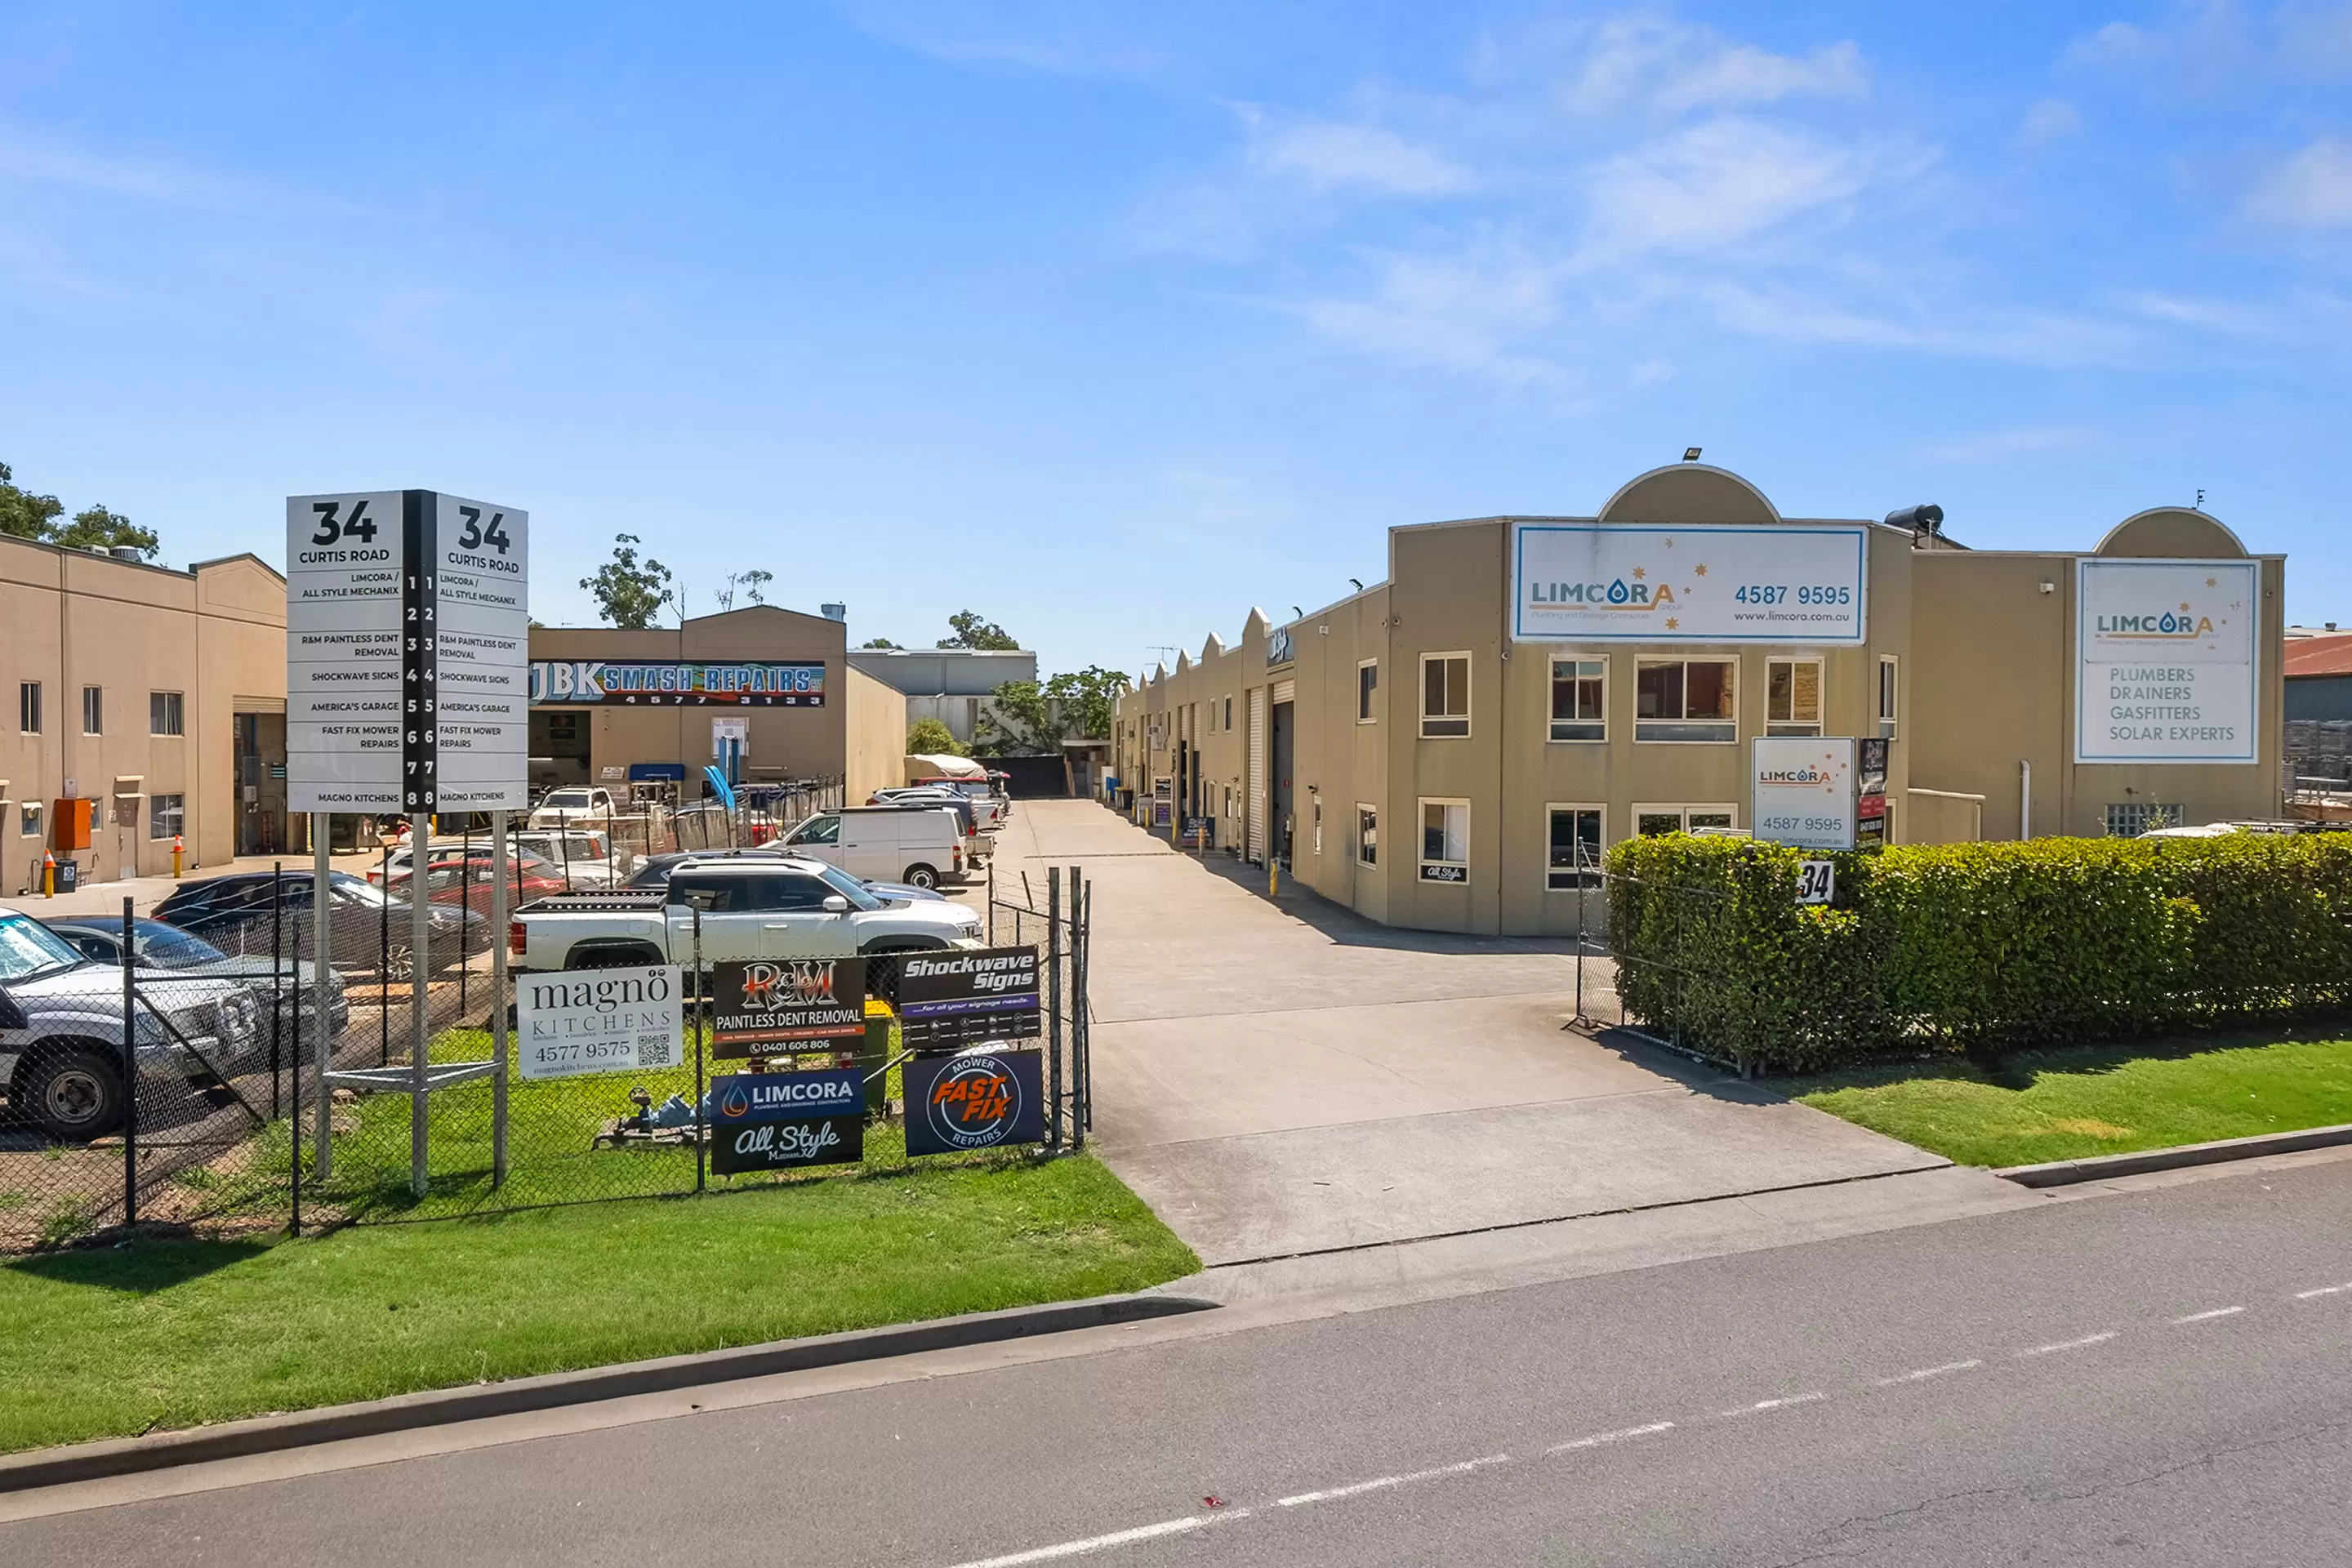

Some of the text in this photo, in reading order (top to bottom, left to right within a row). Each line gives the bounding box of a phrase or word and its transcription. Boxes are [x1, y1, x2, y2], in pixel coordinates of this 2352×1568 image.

[311, 500, 377, 546] 34
[458, 505, 510, 555] 34
[300, 549, 390, 564] CURTIS ROAD
[448, 552, 519, 573] CURTIS ROAD
[351, 572, 393, 582] LIMCORA
[408, 577, 416, 590] 1
[426, 576, 432, 590] 1
[440, 575, 474, 586] LIMCORA
[302, 586, 399, 598] ALL STYLE MECHANIX
[440, 589, 516, 605] ALL STYLE MECHANIX
[1532, 577, 1675, 604] LIMCORA
[1735, 586, 1851, 604] 4587 9595
[408, 608, 417, 621] 2
[425, 608, 434, 621] 2
[1735, 611, 1850, 621] www.limcora.com.au
[2097, 612, 2214, 633] LIMCORA
[301, 634, 399, 644] R&M PAINTLESS DENT
[408, 638, 417, 651] 3
[425, 638, 434, 651] 3
[439, 635, 517, 650] R&M PAINTLESS DENT
[354, 648, 399, 657] REMOVAL
[439, 649, 475, 659] REMOVAL
[311, 671, 399, 681] SHOCKWAVE SIGNS
[407, 669, 418, 681] 4
[424, 669, 434, 681] 4
[439, 673, 510, 684] SHOCKWAVE SIGNS
[604, 667, 693, 692] SMASH
[704, 668, 812, 693] REPAIRS
[2110, 668, 2195, 682] PLUMBERS
[529, 662, 606, 704] JBK
[2110, 687, 2191, 700] DRAINERS
[311, 702, 399, 712] AMERICA'S GARAGE
[408, 700, 417, 712] 5
[425, 700, 434, 712] 5
[440, 704, 510, 713] AMERICA'S GARAGE
[2110, 706, 2201, 720] GASFITTERS
[322, 726, 399, 734] FAST FIX MOWER
[408, 730, 417, 743] 6
[425, 730, 434, 743] 6
[440, 726, 501, 735] FAST FIX MOWER
[2109, 727, 2234, 741] SOLAR EXPERTS
[360, 740, 399, 748] REPAIRS
[440, 740, 471, 748] REPAIRS
[408, 761, 417, 774] 7
[425, 761, 434, 774] 7
[1760, 769, 1831, 782] LIMCORA
[318, 794, 399, 803] MAGNO KITCHENS
[408, 792, 417, 805] 8
[425, 791, 434, 804] 8
[440, 792, 505, 801] MAGNO KITCHENS
[1763, 817, 1842, 831] 4587 9595
[1441, 867, 1461, 880] Style
[1798, 865, 1830, 899] 34
[904, 955, 1035, 978] Shockwave
[973, 972, 1035, 991] Signs
[948, 1003, 967, 1011] your
[533, 1011, 670, 1035] KITCHENS
[717, 1009, 862, 1030] PAINTLESS DENT REMOVAL
[535, 1040, 630, 1062] 4577 9575
[762, 1040, 830, 1052] 0401 606 806
[952, 1057, 996, 1074] MOWER
[752, 1081, 853, 1103] LIMCORA
[933, 1076, 1008, 1105] FAST
[961, 1096, 1012, 1122] FIX
[735, 1120, 840, 1159] All Style
[952, 1128, 1002, 1146] REPAIRS
